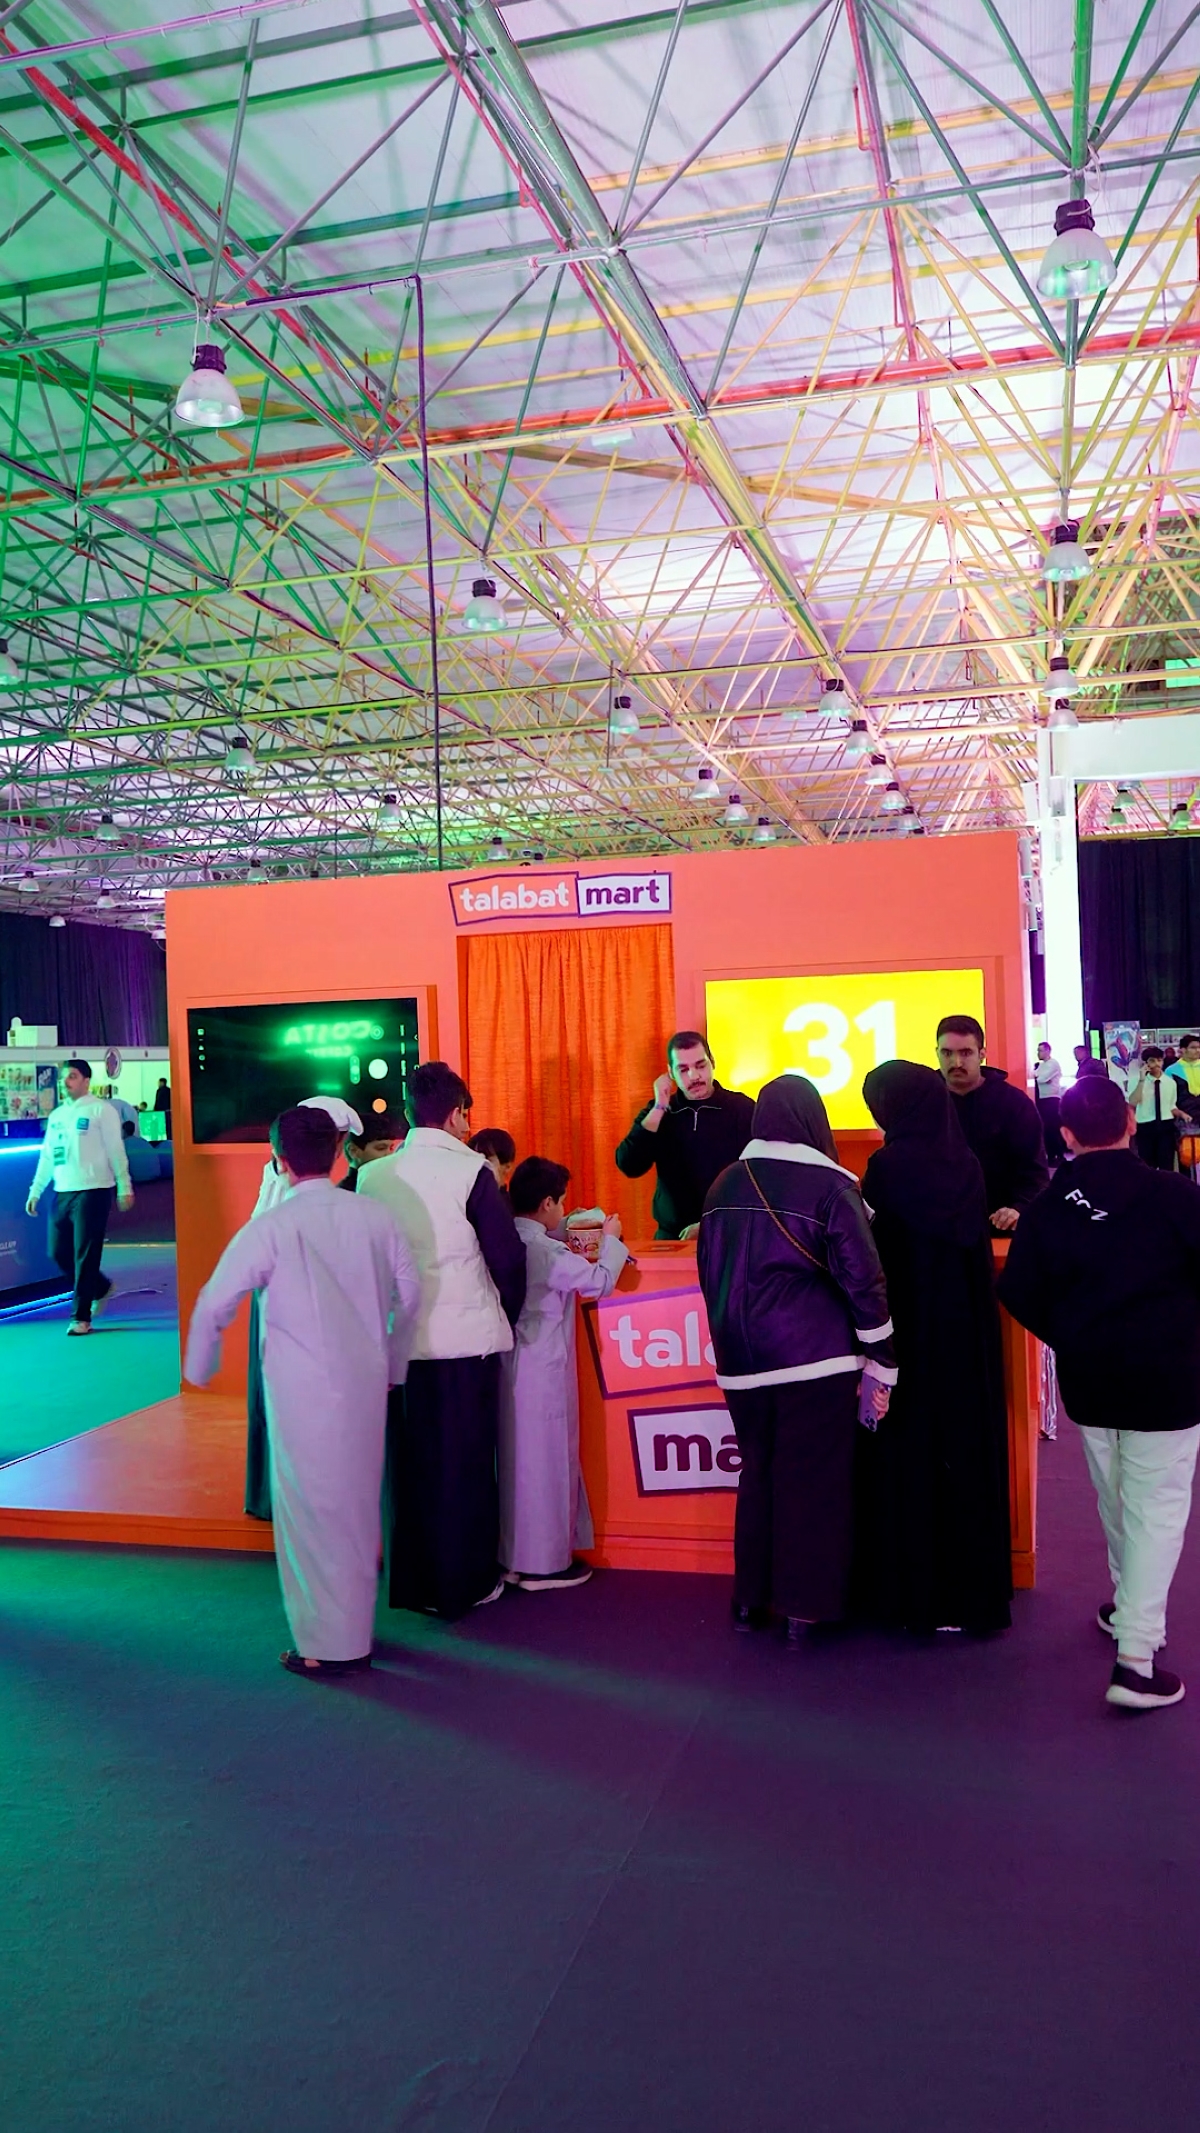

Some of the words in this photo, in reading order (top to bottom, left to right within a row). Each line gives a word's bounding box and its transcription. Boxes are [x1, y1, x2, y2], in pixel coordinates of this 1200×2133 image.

[460, 881, 569, 912] talabat
[585, 879, 660, 906] mart
[783, 1001, 897, 1096] 31
